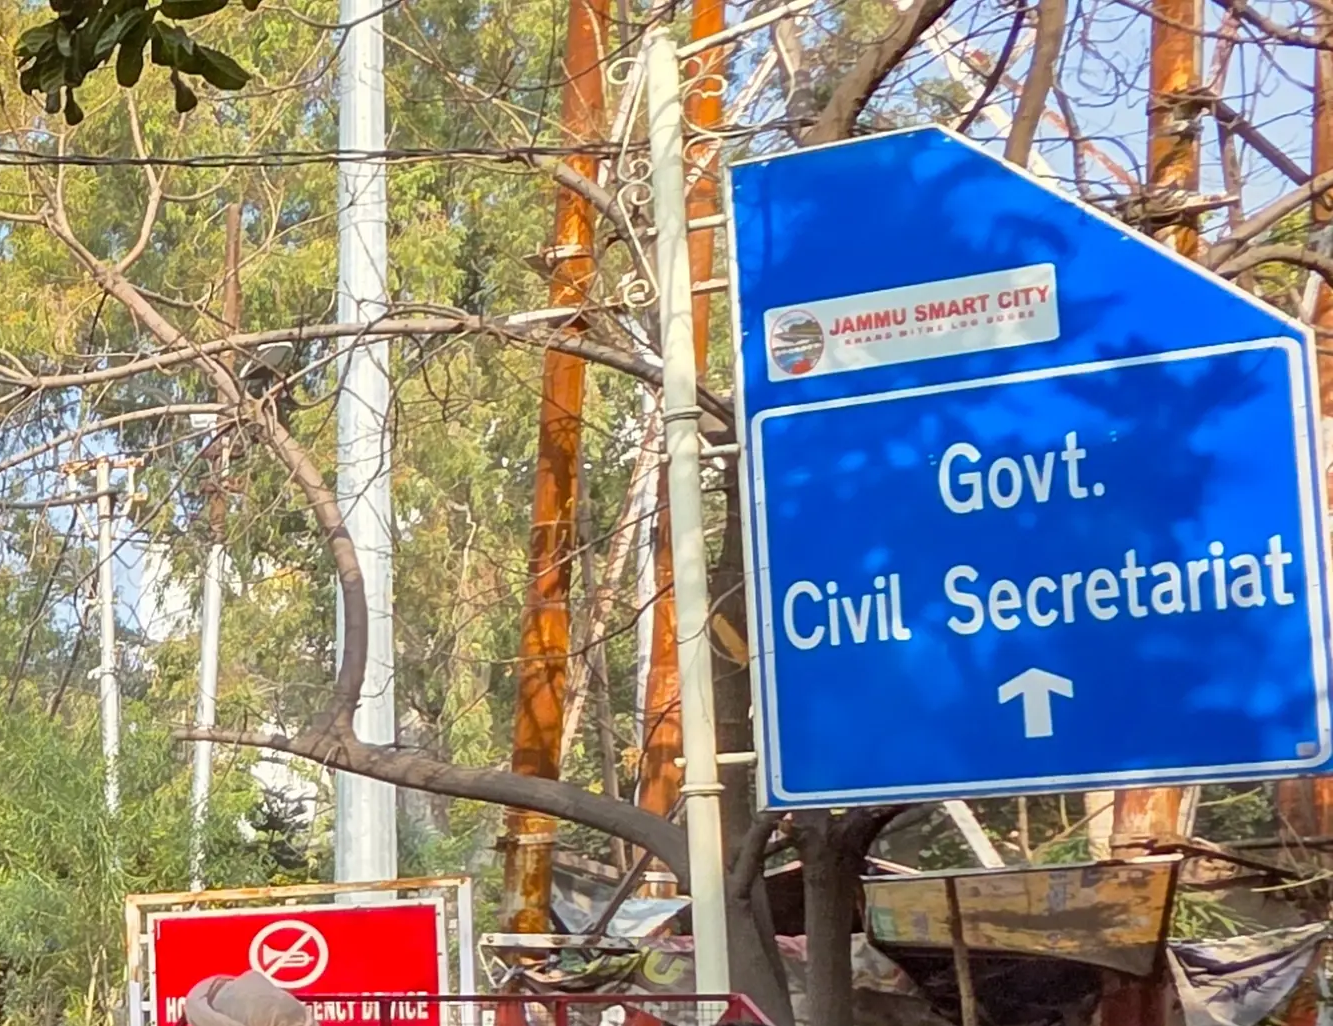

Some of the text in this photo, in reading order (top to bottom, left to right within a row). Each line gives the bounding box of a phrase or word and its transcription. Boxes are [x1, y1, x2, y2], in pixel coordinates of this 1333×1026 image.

[829, 284, 1050, 336] JAMMU SMART CITY
[938, 431, 1106, 514] Govt.
[782, 534, 1295, 651] Civil Secretariat
